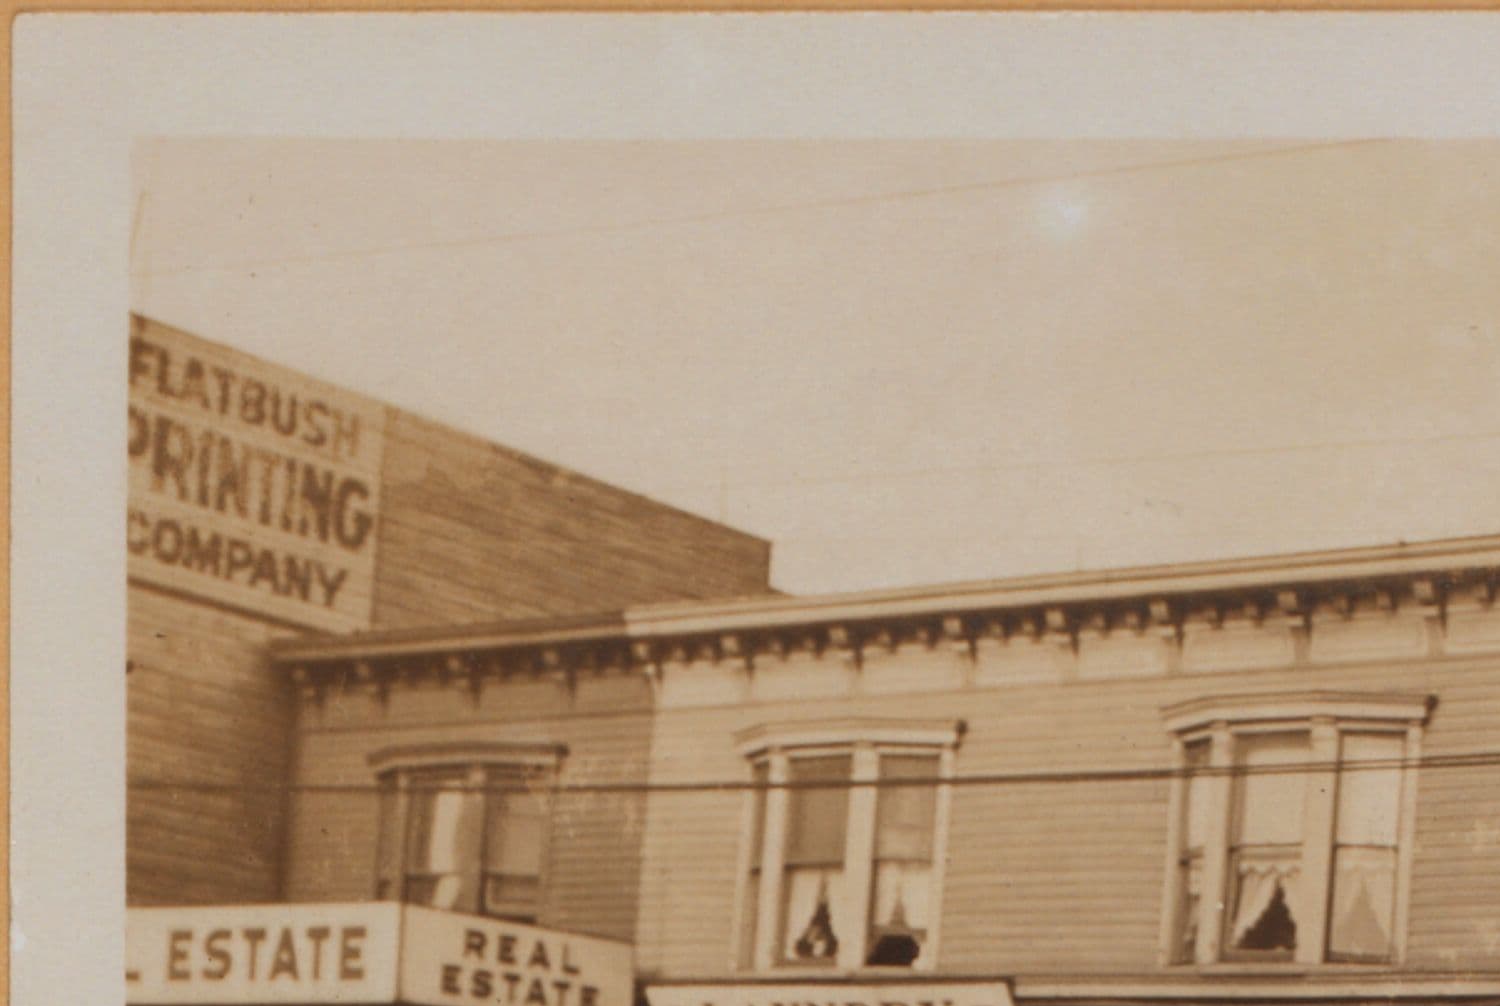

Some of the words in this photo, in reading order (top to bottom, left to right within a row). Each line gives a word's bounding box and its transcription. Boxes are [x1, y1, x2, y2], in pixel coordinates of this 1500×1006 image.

[129, 334, 361, 460] FLATBUSH
[128, 508, 348, 608] COMPANY
[168, 926, 367, 981] ESTATE
[464, 928, 580, 977] REAL
